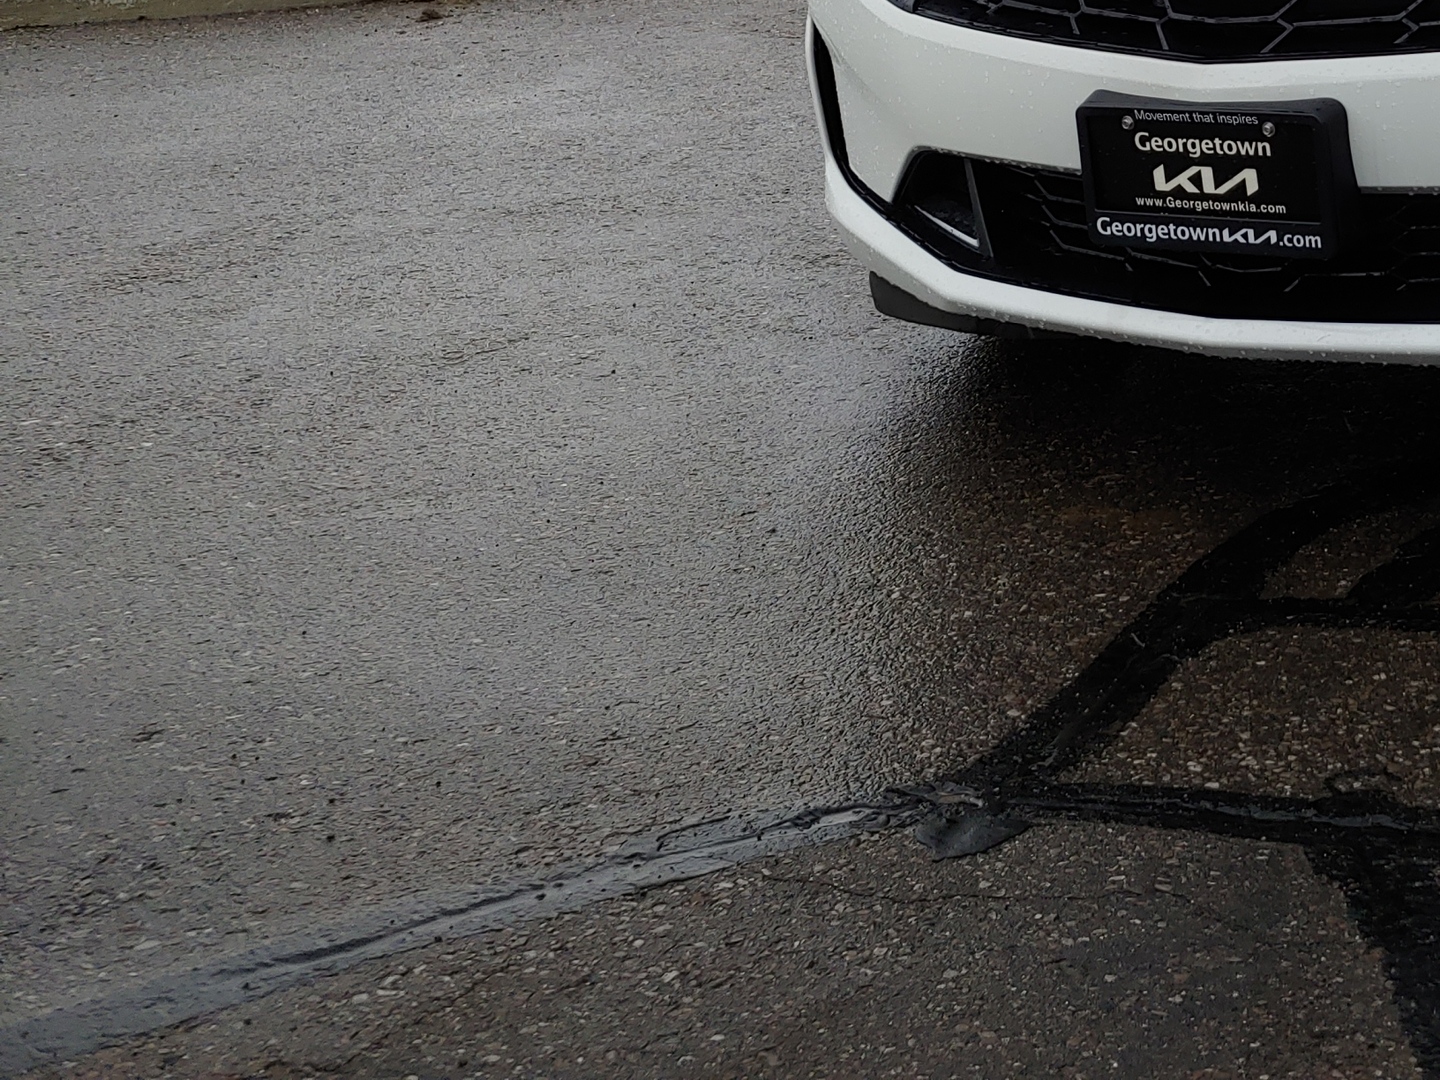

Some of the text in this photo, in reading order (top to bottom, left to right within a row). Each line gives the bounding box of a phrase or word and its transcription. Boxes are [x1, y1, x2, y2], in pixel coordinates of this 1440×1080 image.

[1134, 109, 1259, 126] Movement that inspires
[1134, 131, 1272, 158] Georgetown
[1153, 164, 1259, 196] KIA
